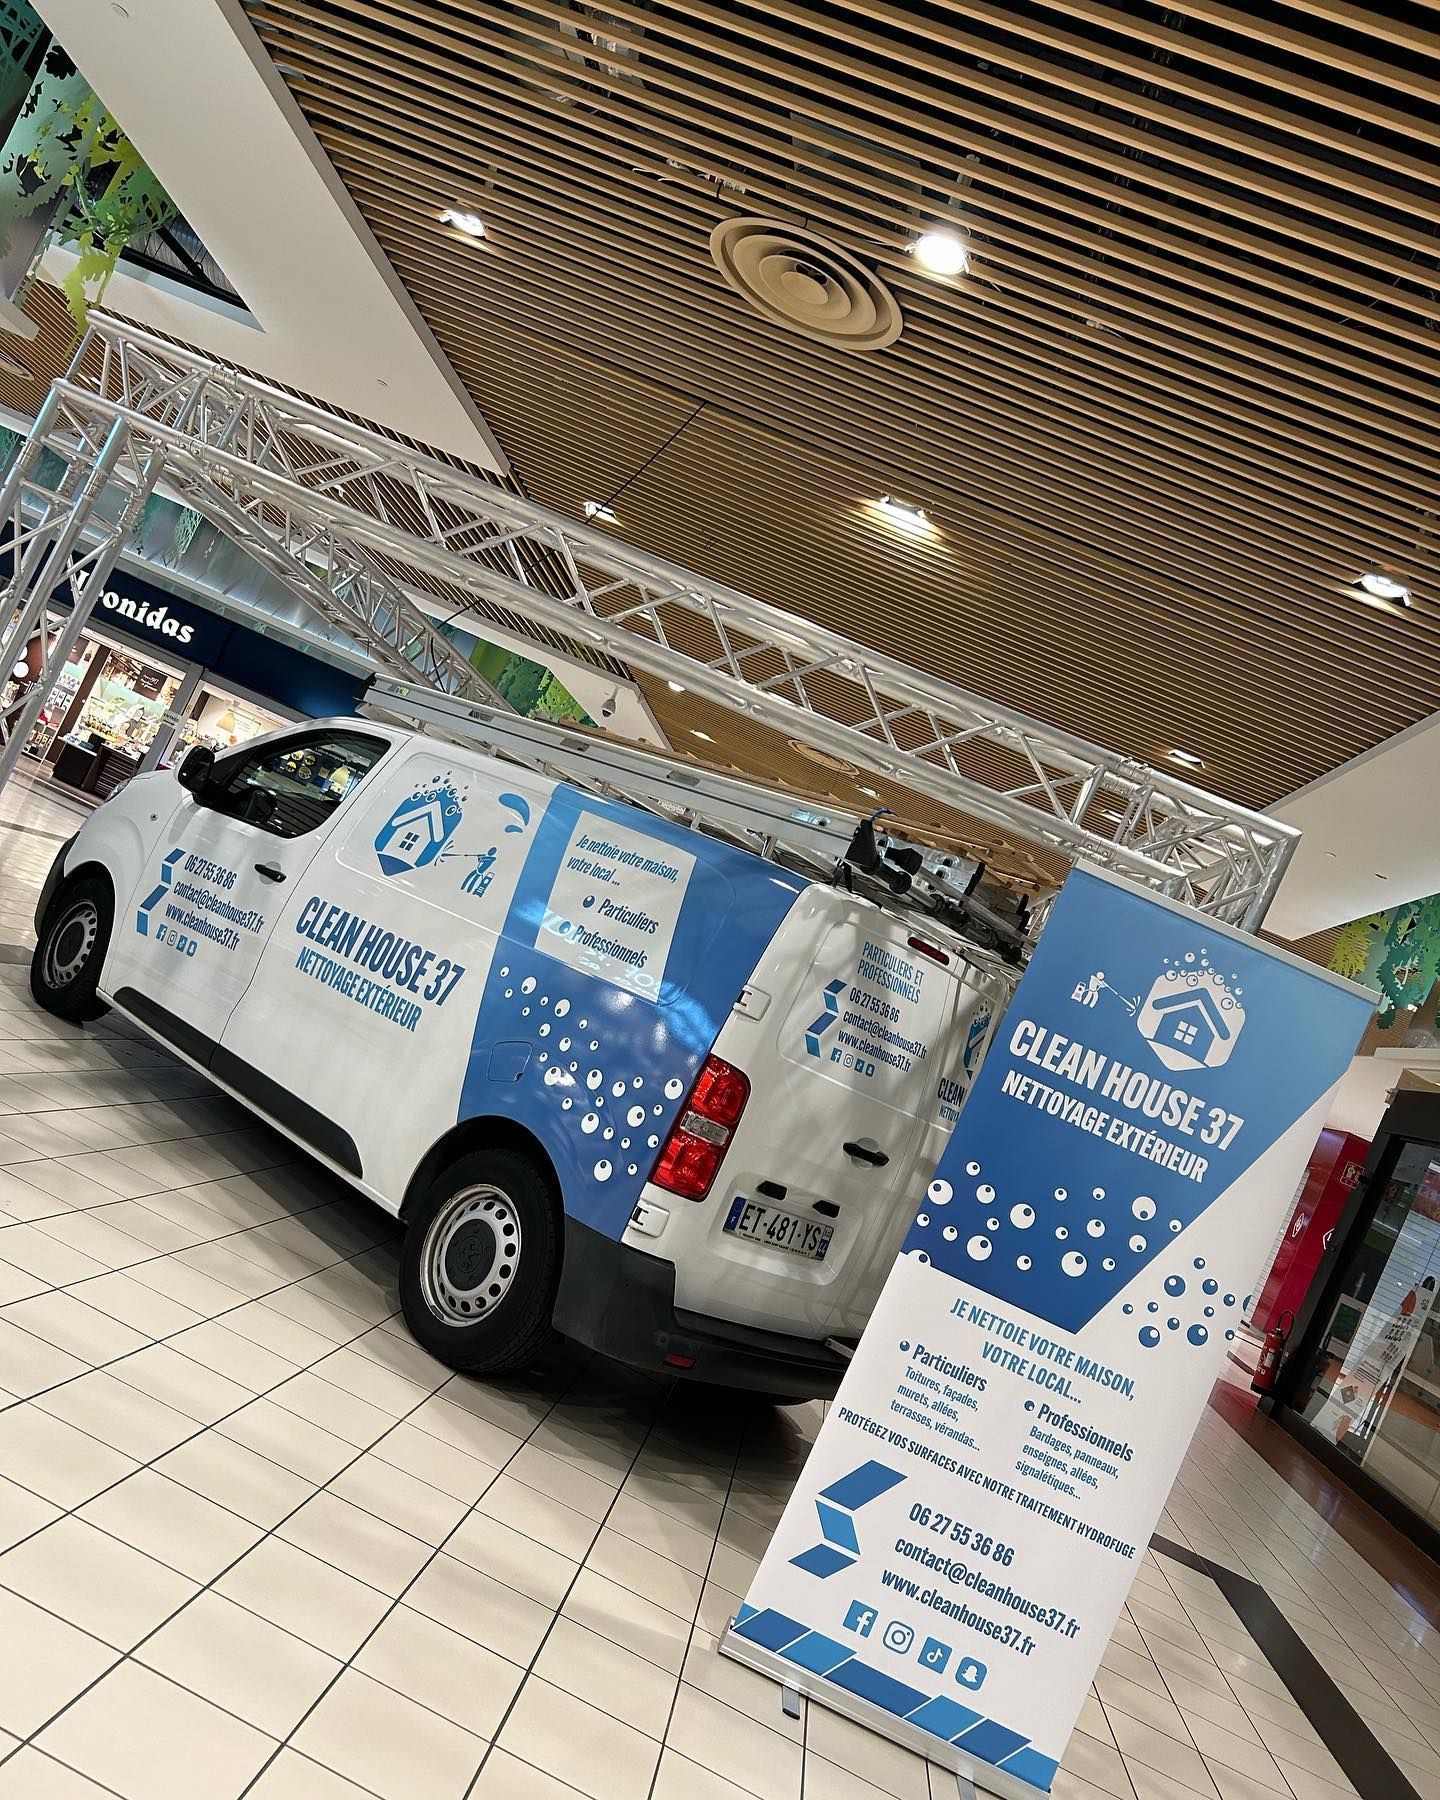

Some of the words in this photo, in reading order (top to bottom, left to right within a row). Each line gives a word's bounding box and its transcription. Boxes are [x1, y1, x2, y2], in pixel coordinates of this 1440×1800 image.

[71, 569, 195, 643] Lonidas
[184, 854, 199, 872] 06
[194, 858, 206, 876] 27
[203, 863, 217, 881] 55
[212, 866, 226, 885] 36
[222, 871, 237, 890] 86
[567, 857, 592, 873] votre
[589, 862, 616, 882] local
[576, 834, 588, 848] Je
[586, 840, 620, 859] nettoie
[619, 850, 643, 868] votre
[641, 859, 679, 883] maison,
[165, 903, 241, 951] www.cleanhouse37.fr
[173, 881, 265, 934] contact@cleanhouse37.fr
[597, 898, 659, 934] Particuliers
[295, 896, 366, 958] CLEAN
[353, 924, 437, 993] HOUSE
[423, 959, 466, 1006] 37
[572, 925, 648, 969] Professionnels
[862, 941, 914, 981] PARTICULIERS
[915, 970, 925, 987] ET
[295, 946, 361, 999] NETTOYAGE
[354, 977, 423, 1032] EXTÉRIEUR
[849, 987, 861, 1004] 06
[860, 992, 871, 1009] 27
[869, 997, 881, 1015] 55
[879, 1002, 891, 1019] 36
[889, 1007, 900, 1023] 86
[857, 959, 921, 1004] PROFESSIONNELS
[837, 1030, 912, 1073] www.cleanhouse37.fr
[843, 1010, 928, 1060] contact@cleanhouse37.fr
[937, 1077, 965, 1108] CLEAN
[1009, 1019, 1108, 1091] CLEAN
[1100, 1061, 1206, 1136] HOUSE
[1200, 1107, 1245, 1151] 37
[1001, 1069, 1110, 1138] NETTOYAGE
[1105, 1117, 1210, 1184] EXTÉRIEUR
[912, 1343, 988, 1392] Particuliers
[949, 1298, 970, 1319] JE
[967, 1305, 1030, 1347] NETTOIE
[1028, 1333, 1076, 1369] VOTRE
[1073, 1355, 1136, 1401] MAISON,
[981, 1341, 1029, 1377] VOTRE
[1027, 1364, 1082, 1404] LOCAL...
[896, 1384, 930, 1409] murets,
[931, 1399, 959, 1422] allées,
[905, 1366, 942, 1394] Toitures,
[942, 1384, 979, 1412] façades,
[890, 1399, 933, 1430] terrasses,
[934, 1420, 980, 1451] vérandas...
[1037, 1403, 1134, 1462] Professionnels
[1022, 1444, 1069, 1475] enseignes,
[1069, 1465, 1099, 1490] allées,
[1029, 1425, 1073, 1457] Bardages,
[1073, 1448, 1119, 1480] panneaux,
[838, 1406, 889, 1440] PROTÉGEZ
[888, 1430, 908, 1449] VOS
[907, 1440, 958, 1473] SURFACES
[955, 1464, 983, 1485] AVEC
[982, 1476, 1017, 1501] NOTRE
[1015, 1491, 1079, 1531] TRAITEMENT
[1076, 1522, 1136, 1559] HYDROFUGE
[1015, 1460, 1081, 1500] signalétiques...
[909, 1502, 932, 1527] 06
[930, 1513, 953, 1536] 27
[950, 1521, 973, 1546] 55
[970, 1532, 993, 1556] 36
[992, 1543, 1015, 1567] 86
[881, 1569, 1036, 1657] www.cleanhouse37.fr
[895, 1538, 1081, 1639] contact@cleanhouse37.fr
